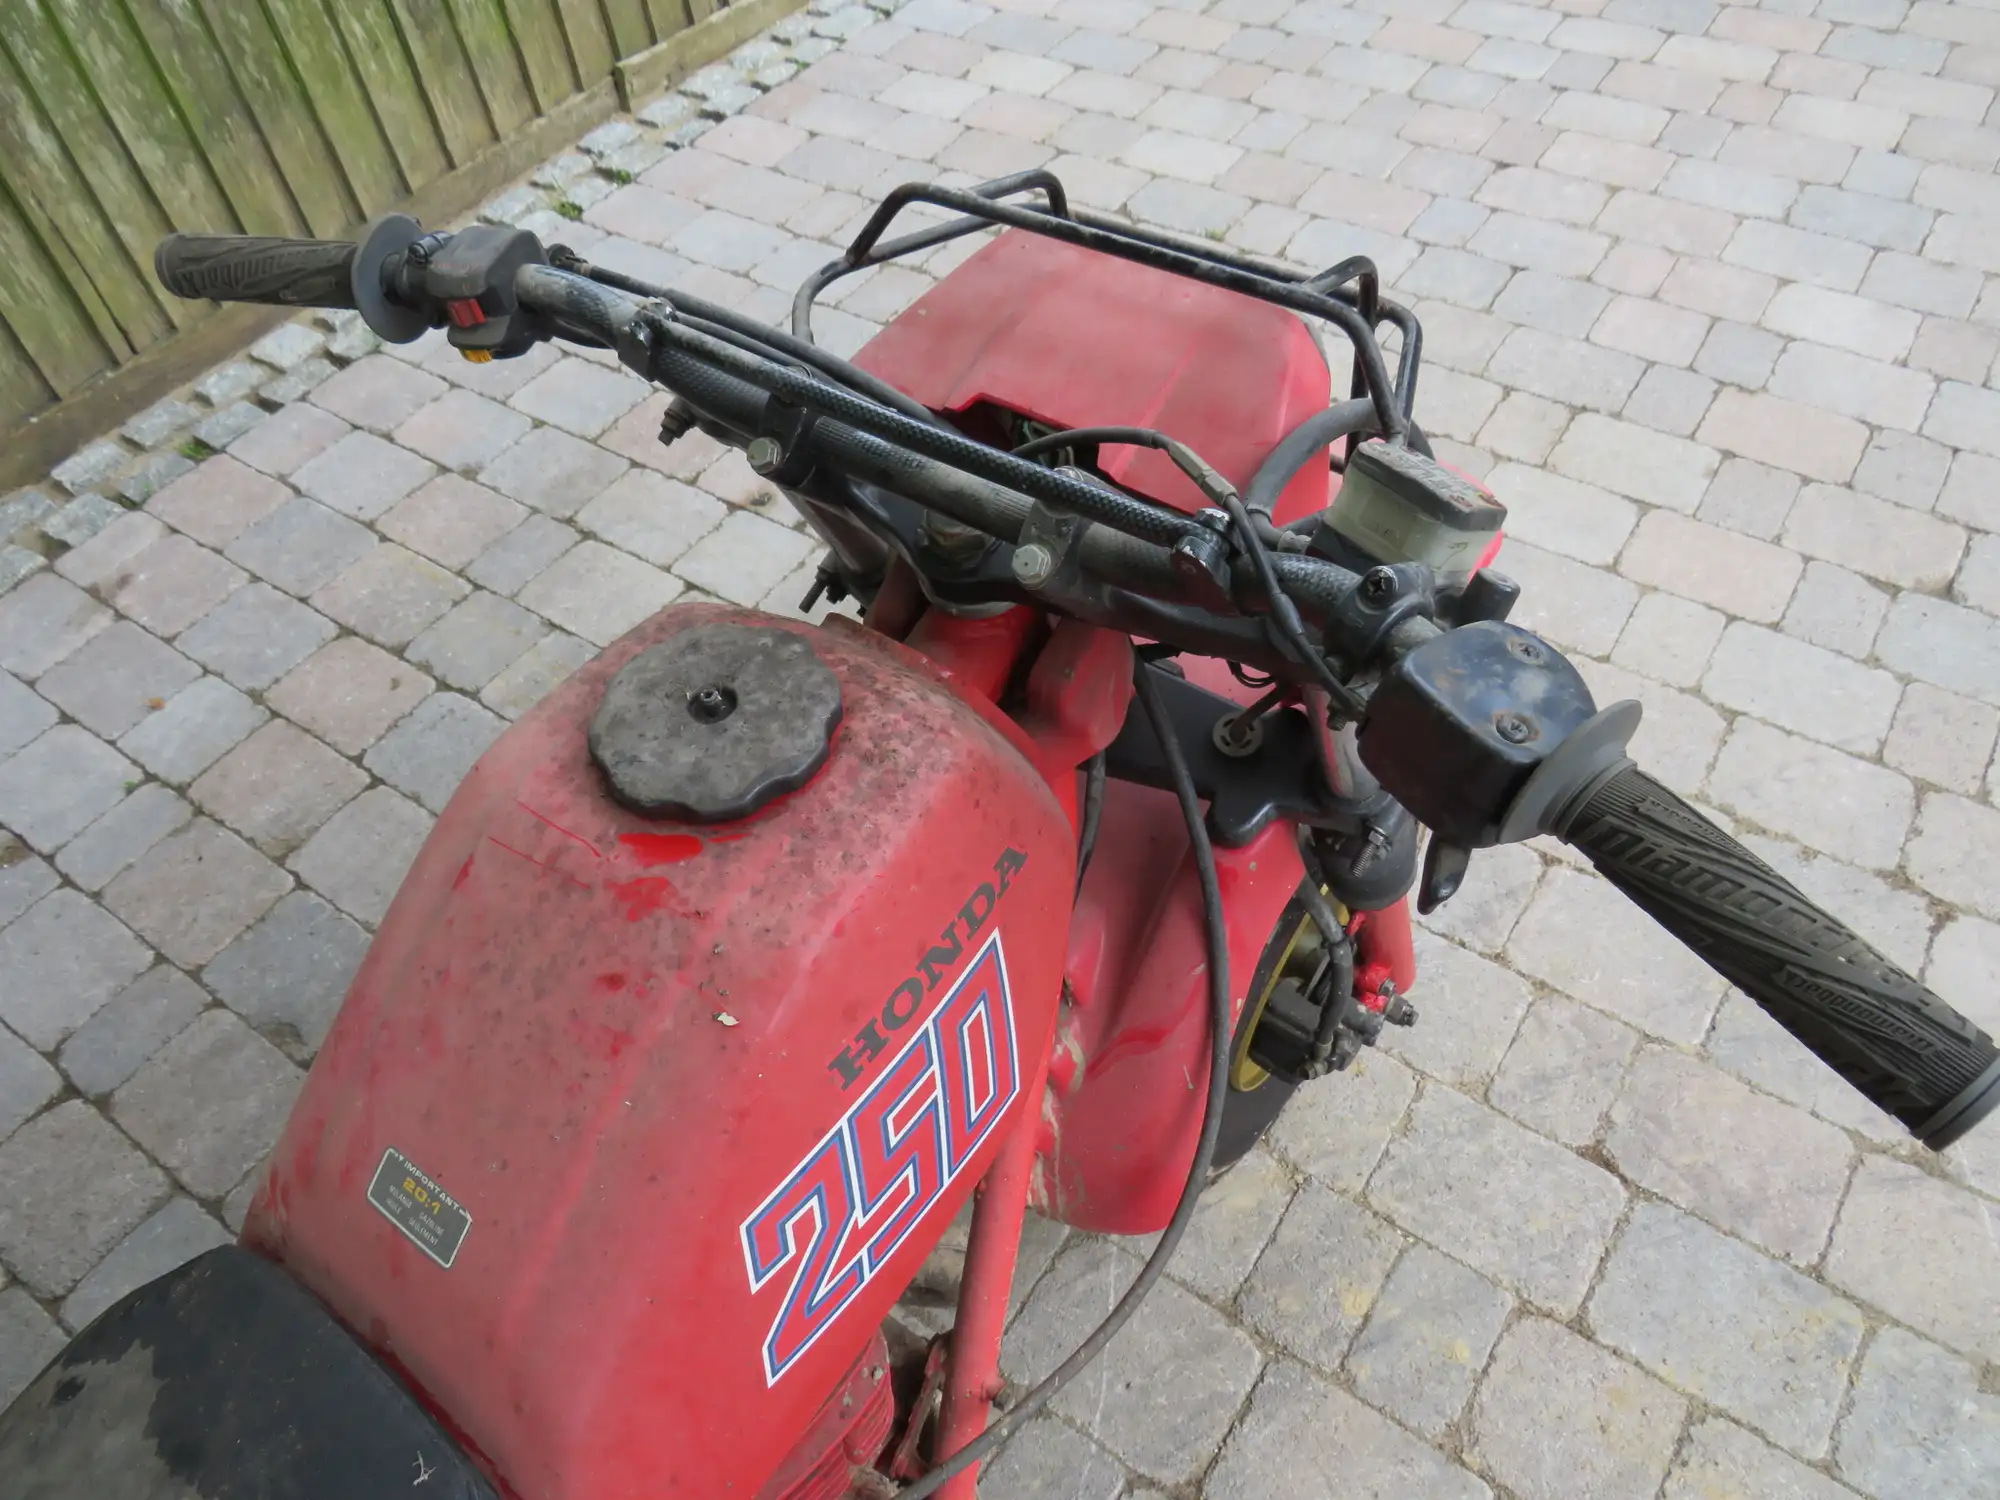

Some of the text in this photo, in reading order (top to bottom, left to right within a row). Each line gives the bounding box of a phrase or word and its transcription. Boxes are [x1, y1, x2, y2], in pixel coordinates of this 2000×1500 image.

[828, 846, 1028, 1091] HONDA
[403, 1177, 440, 1215] 20:1
[404, 1160, 460, 1211] IMPORTANT
[740, 926, 1020, 1389] 250
